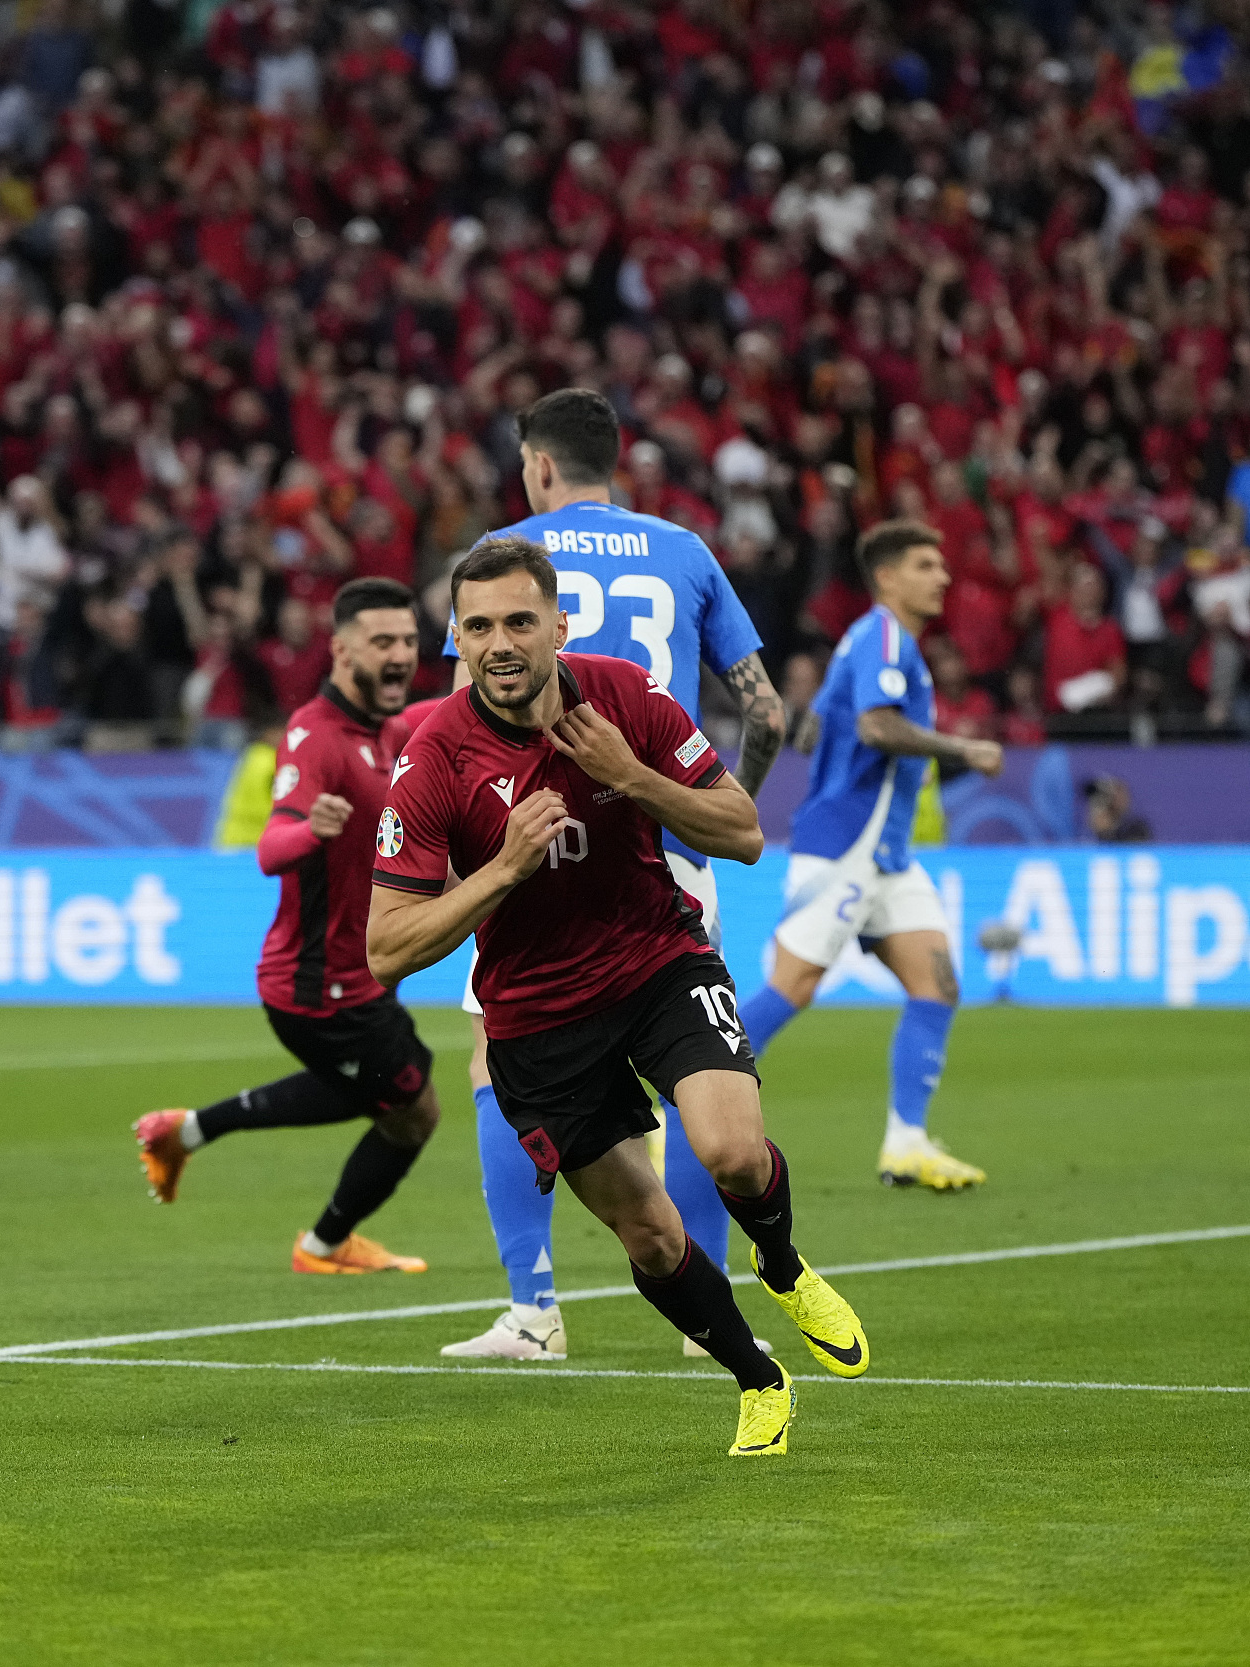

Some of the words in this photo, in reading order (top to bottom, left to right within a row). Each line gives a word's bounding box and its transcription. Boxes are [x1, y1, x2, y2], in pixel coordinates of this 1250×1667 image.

[543, 529, 649, 557] BASTONI
[556, 570, 676, 689] 23
[676, 745, 688, 757] UEFA
[545, 816, 589, 869] 10
[837, 883, 863, 922] 2
[985, 856, 1250, 1006] Alip
[690, 984, 740, 1032] 10
